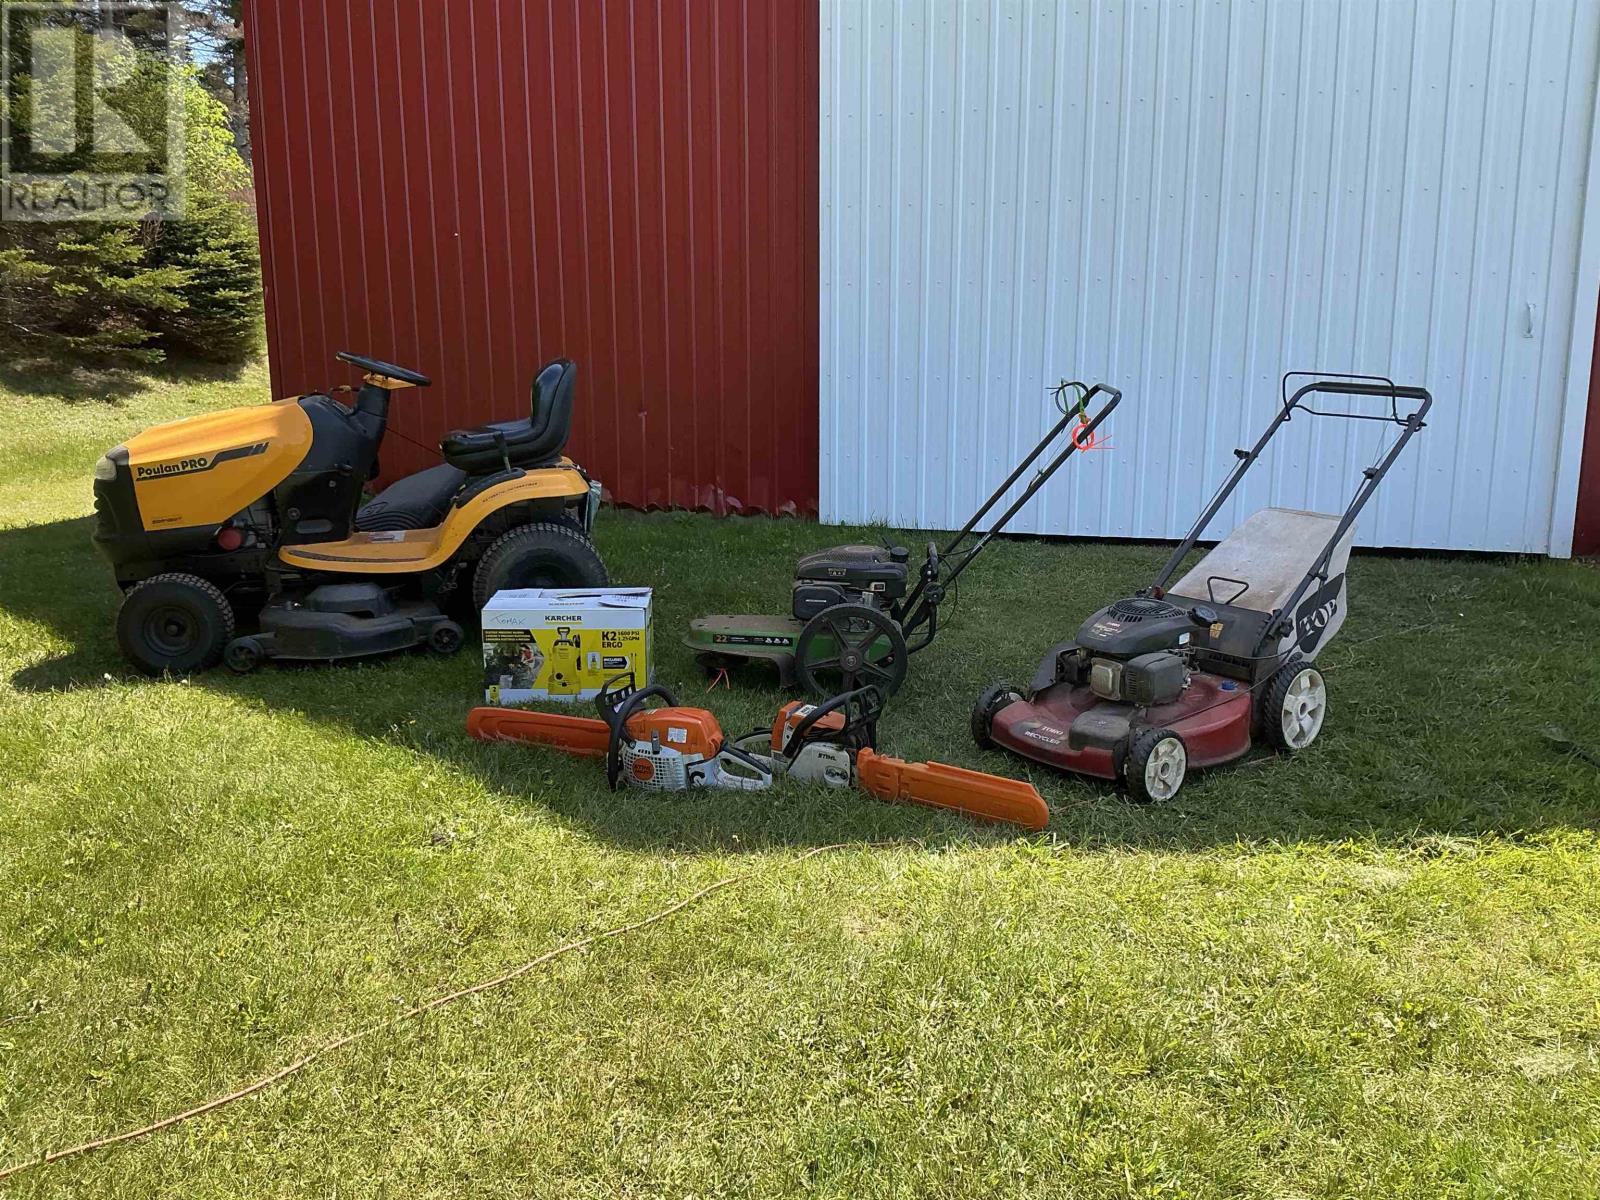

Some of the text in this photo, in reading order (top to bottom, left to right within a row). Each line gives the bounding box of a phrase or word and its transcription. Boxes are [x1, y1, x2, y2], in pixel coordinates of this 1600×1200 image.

[137, 457, 208, 476] Poulan PRO
[601, 631, 617, 641] K2
